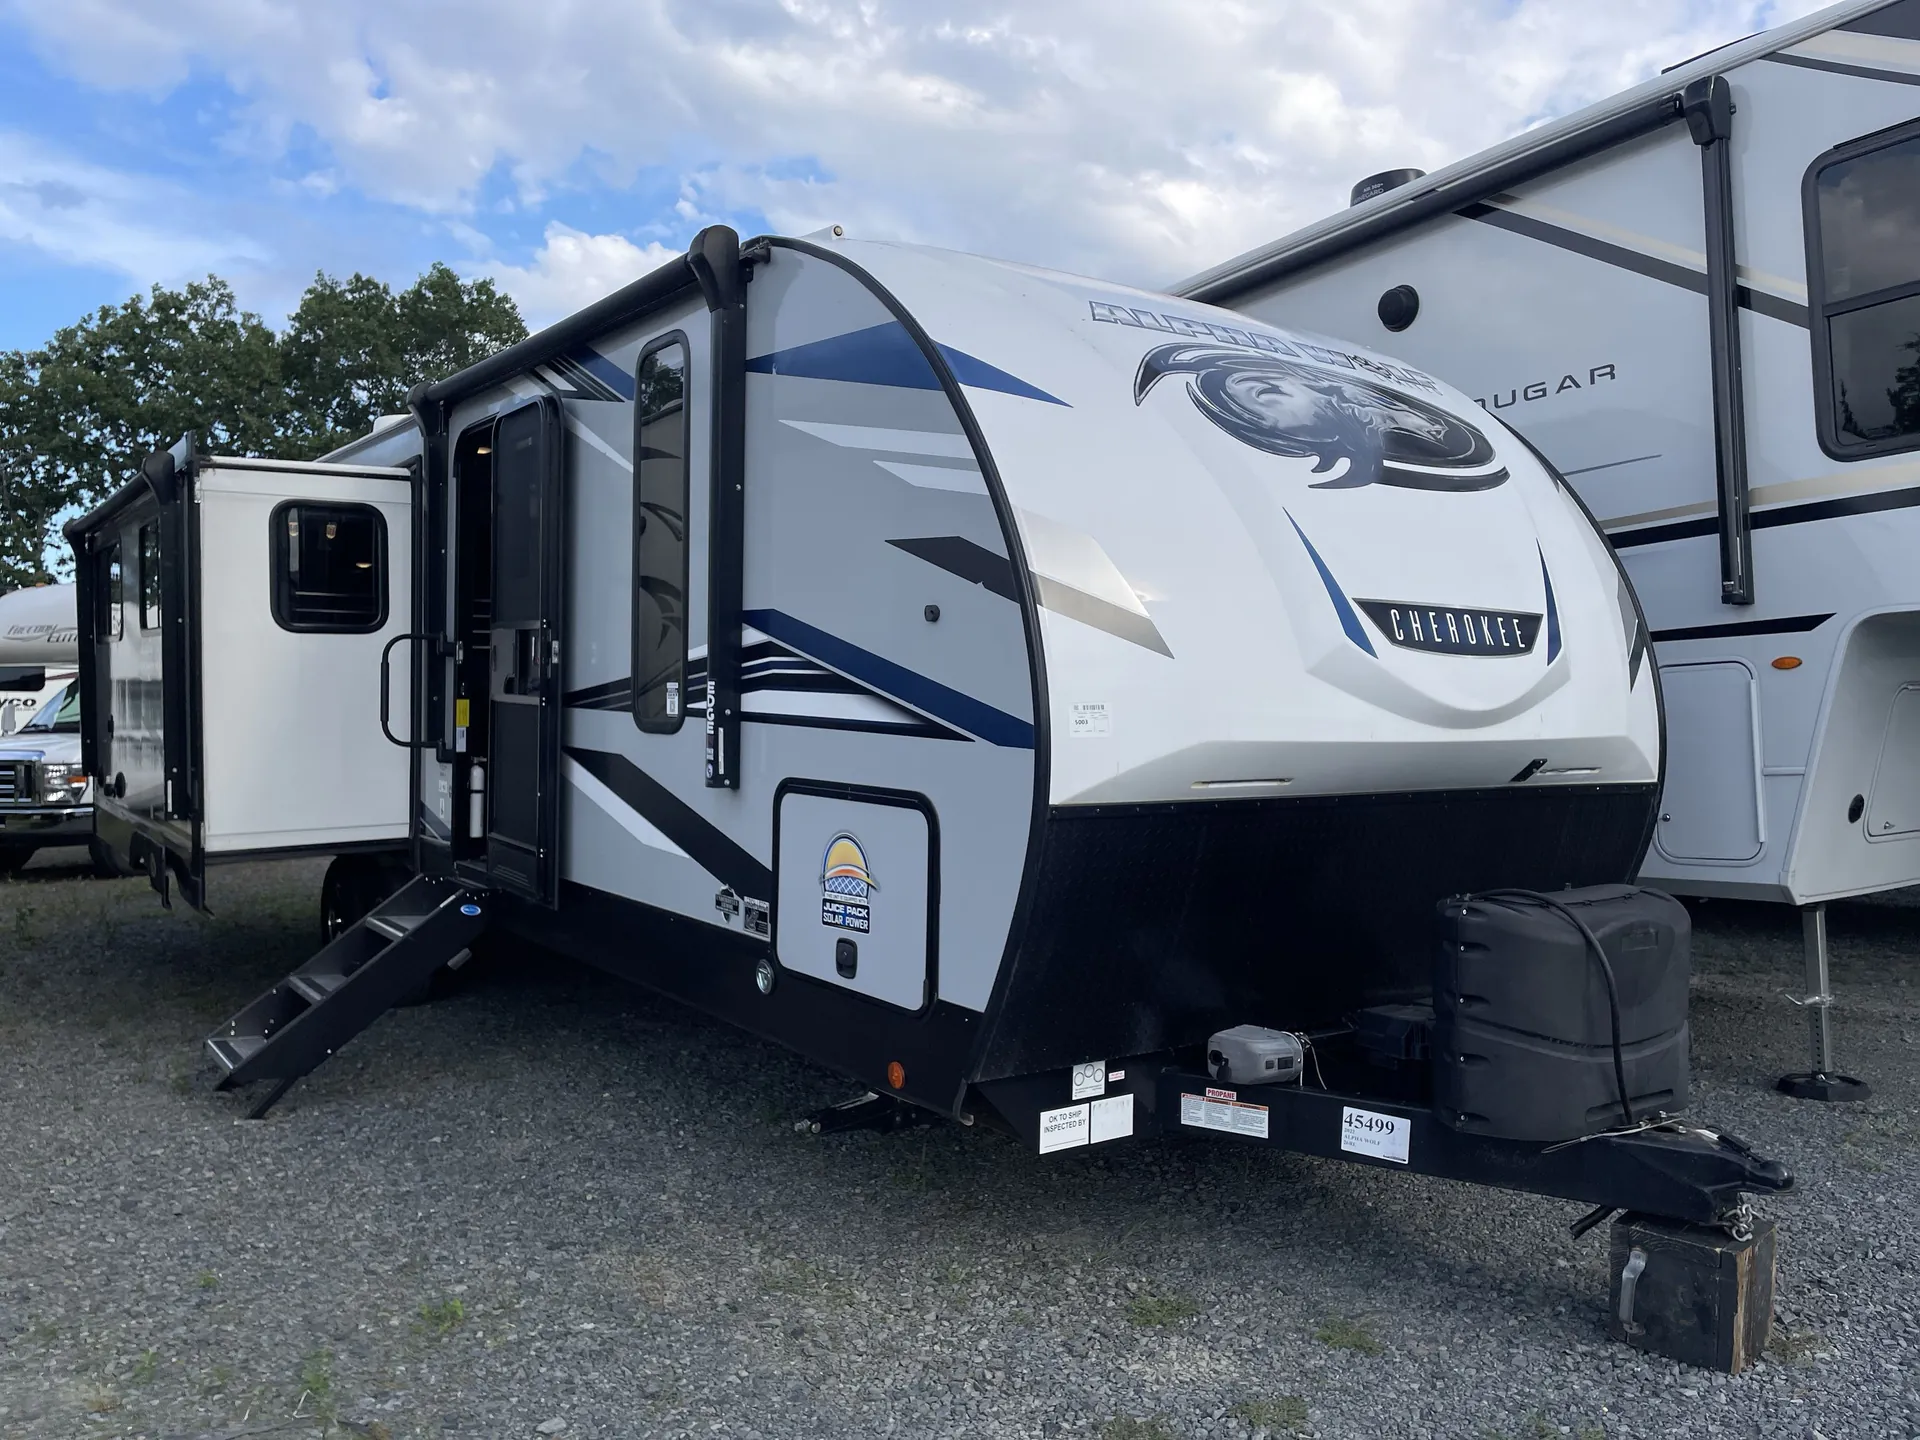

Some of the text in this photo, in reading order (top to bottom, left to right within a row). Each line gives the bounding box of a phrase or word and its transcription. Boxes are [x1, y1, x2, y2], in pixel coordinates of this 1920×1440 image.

[1089, 300, 1301, 358] ALPHA
[1390, 608, 1526, 648] CHEROKEE
[706, 680, 716, 734] EDGE
[823, 902, 869, 918] JUICE PACK
[823, 912, 869, 930] SOLAR POWER
[1207, 1088, 1236, 1100] PROPANE
[1048, 1110, 1082, 1123] OK TO SHIP
[1344, 1112, 1395, 1135] 45499
[1043, 1119, 1087, 1133] INSPECTED BY
[1344, 1134, 1381, 1146] ALPHA WOLF
